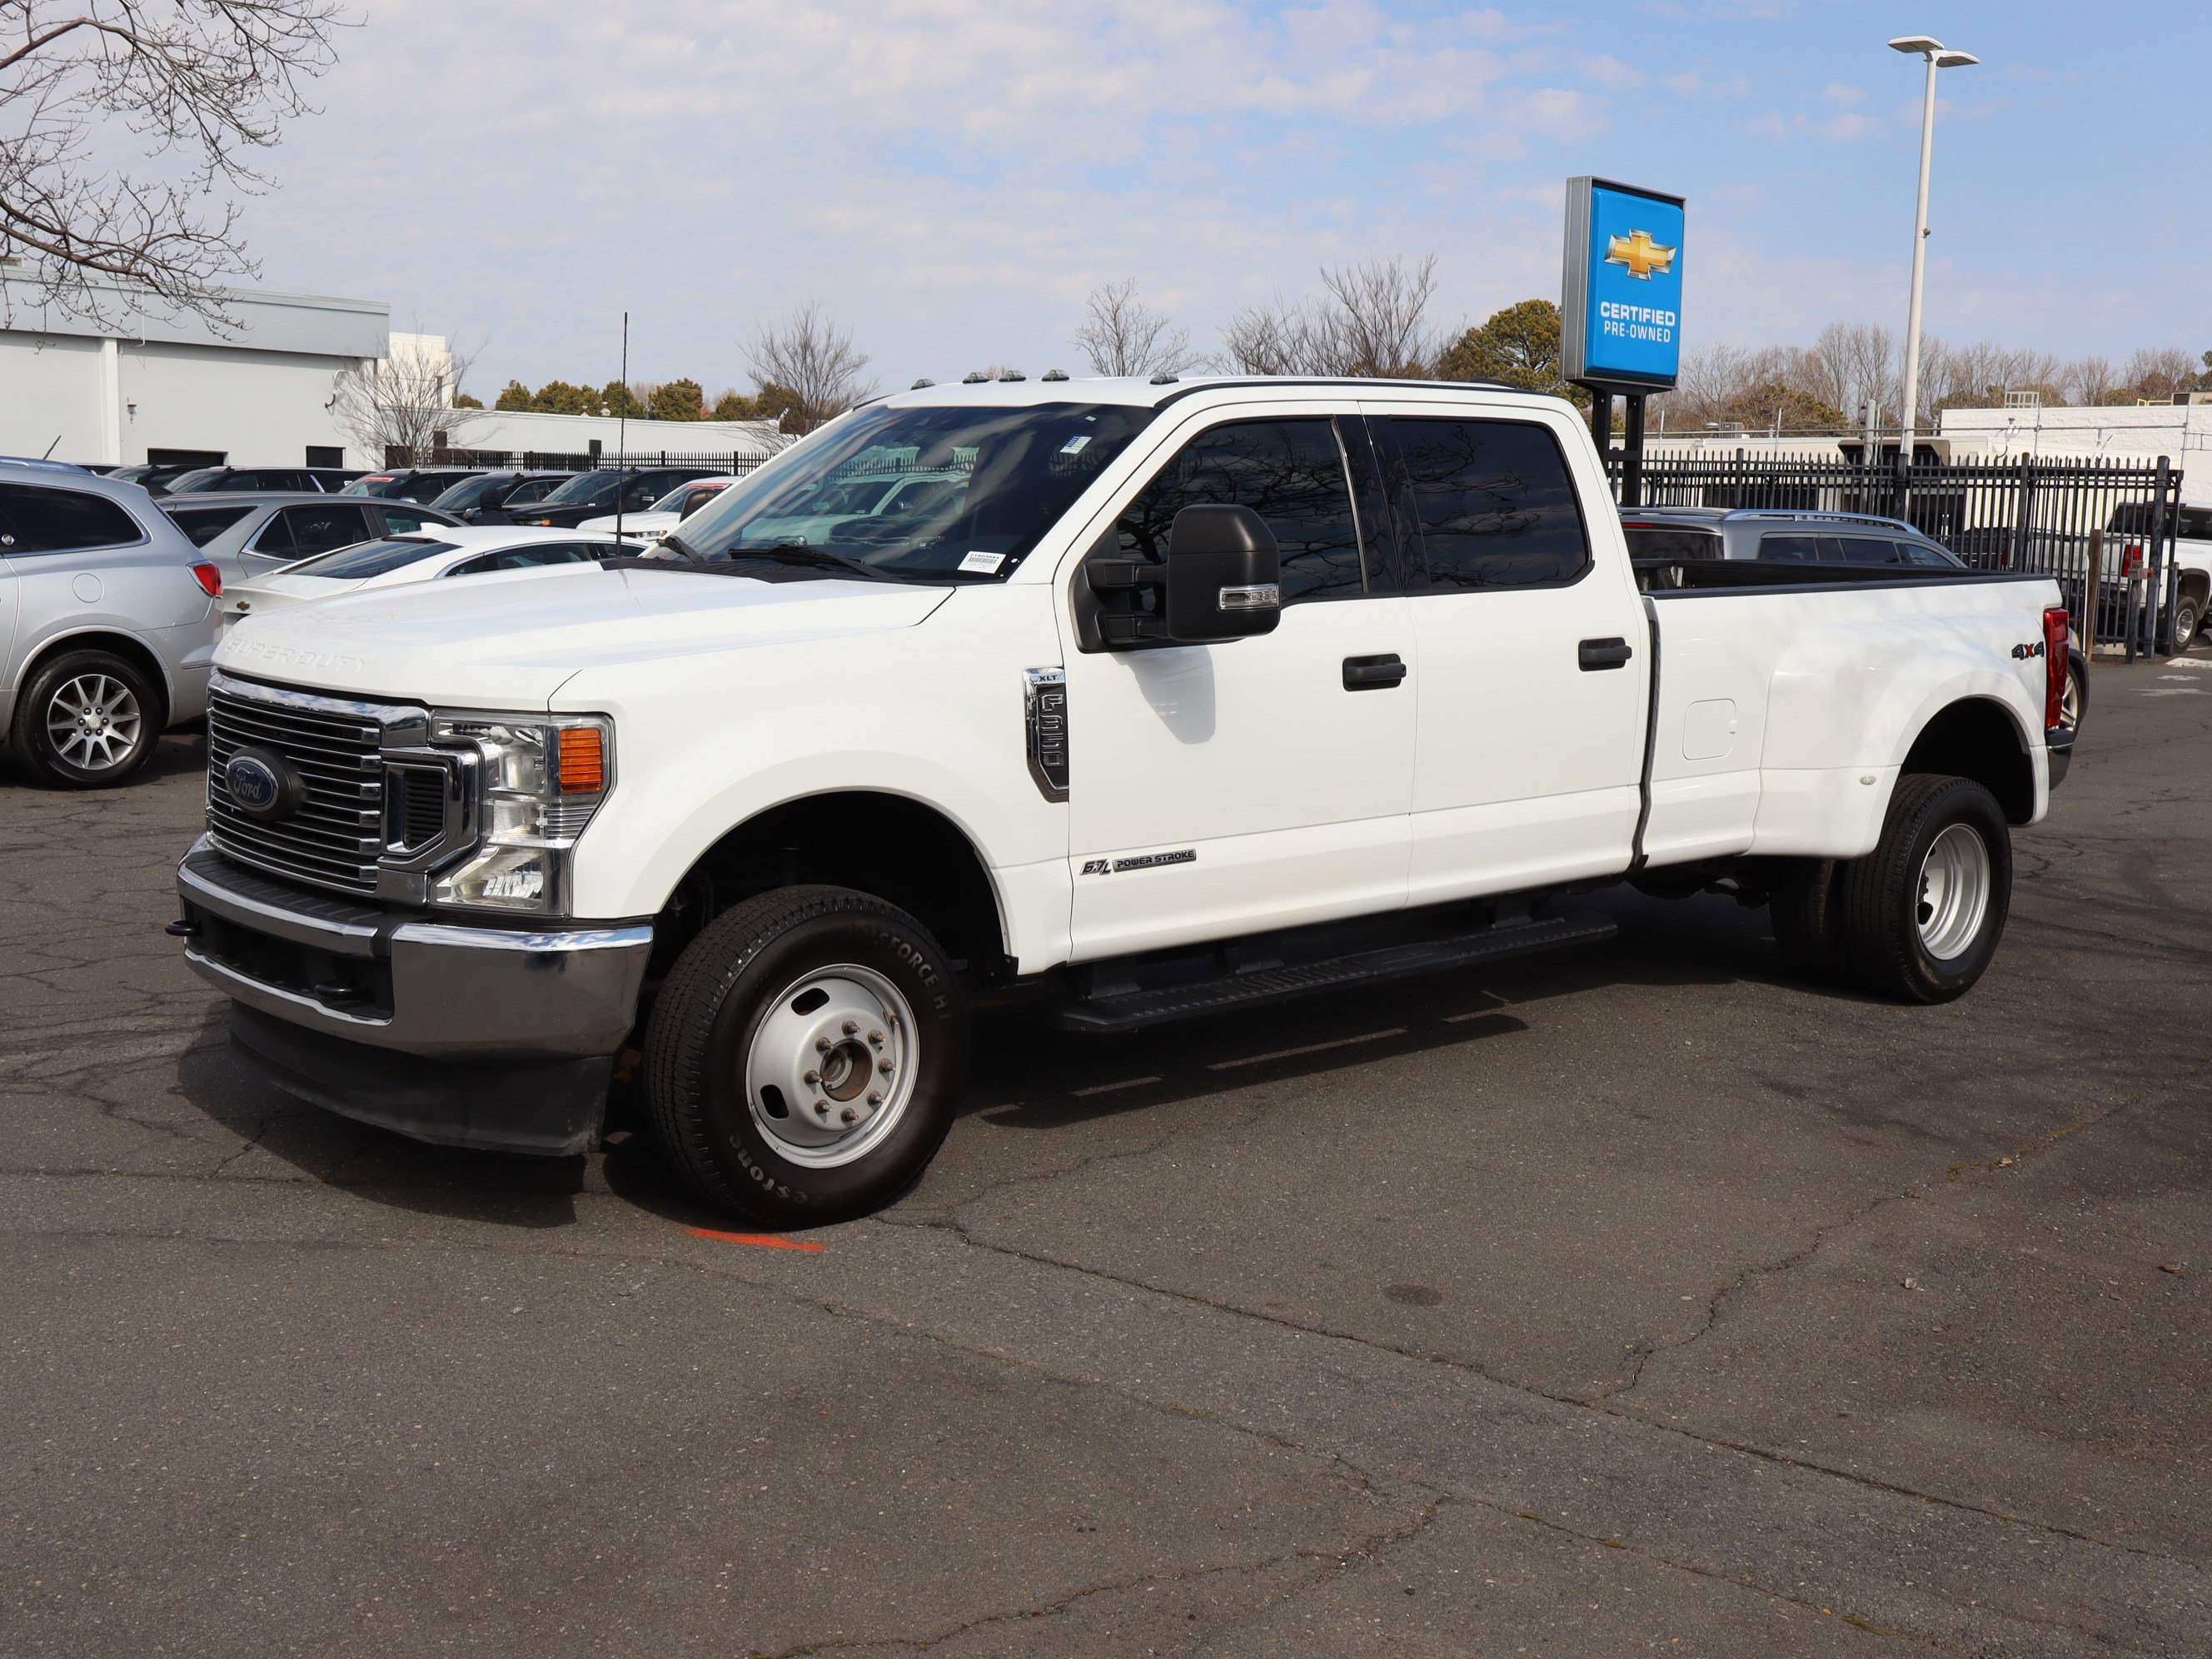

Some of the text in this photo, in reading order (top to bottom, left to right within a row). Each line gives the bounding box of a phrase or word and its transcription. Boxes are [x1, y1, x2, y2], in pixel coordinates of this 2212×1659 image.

[1601, 301, 1676, 326] CERTIFIED
[1604, 320, 1671, 343] PRE-OWNED
[225, 638, 366, 675] SUPER DUTY
[234, 766, 263, 800] Ford
[1117, 857, 1153, 868] POWER
[1154, 850, 1194, 863] STROKE
